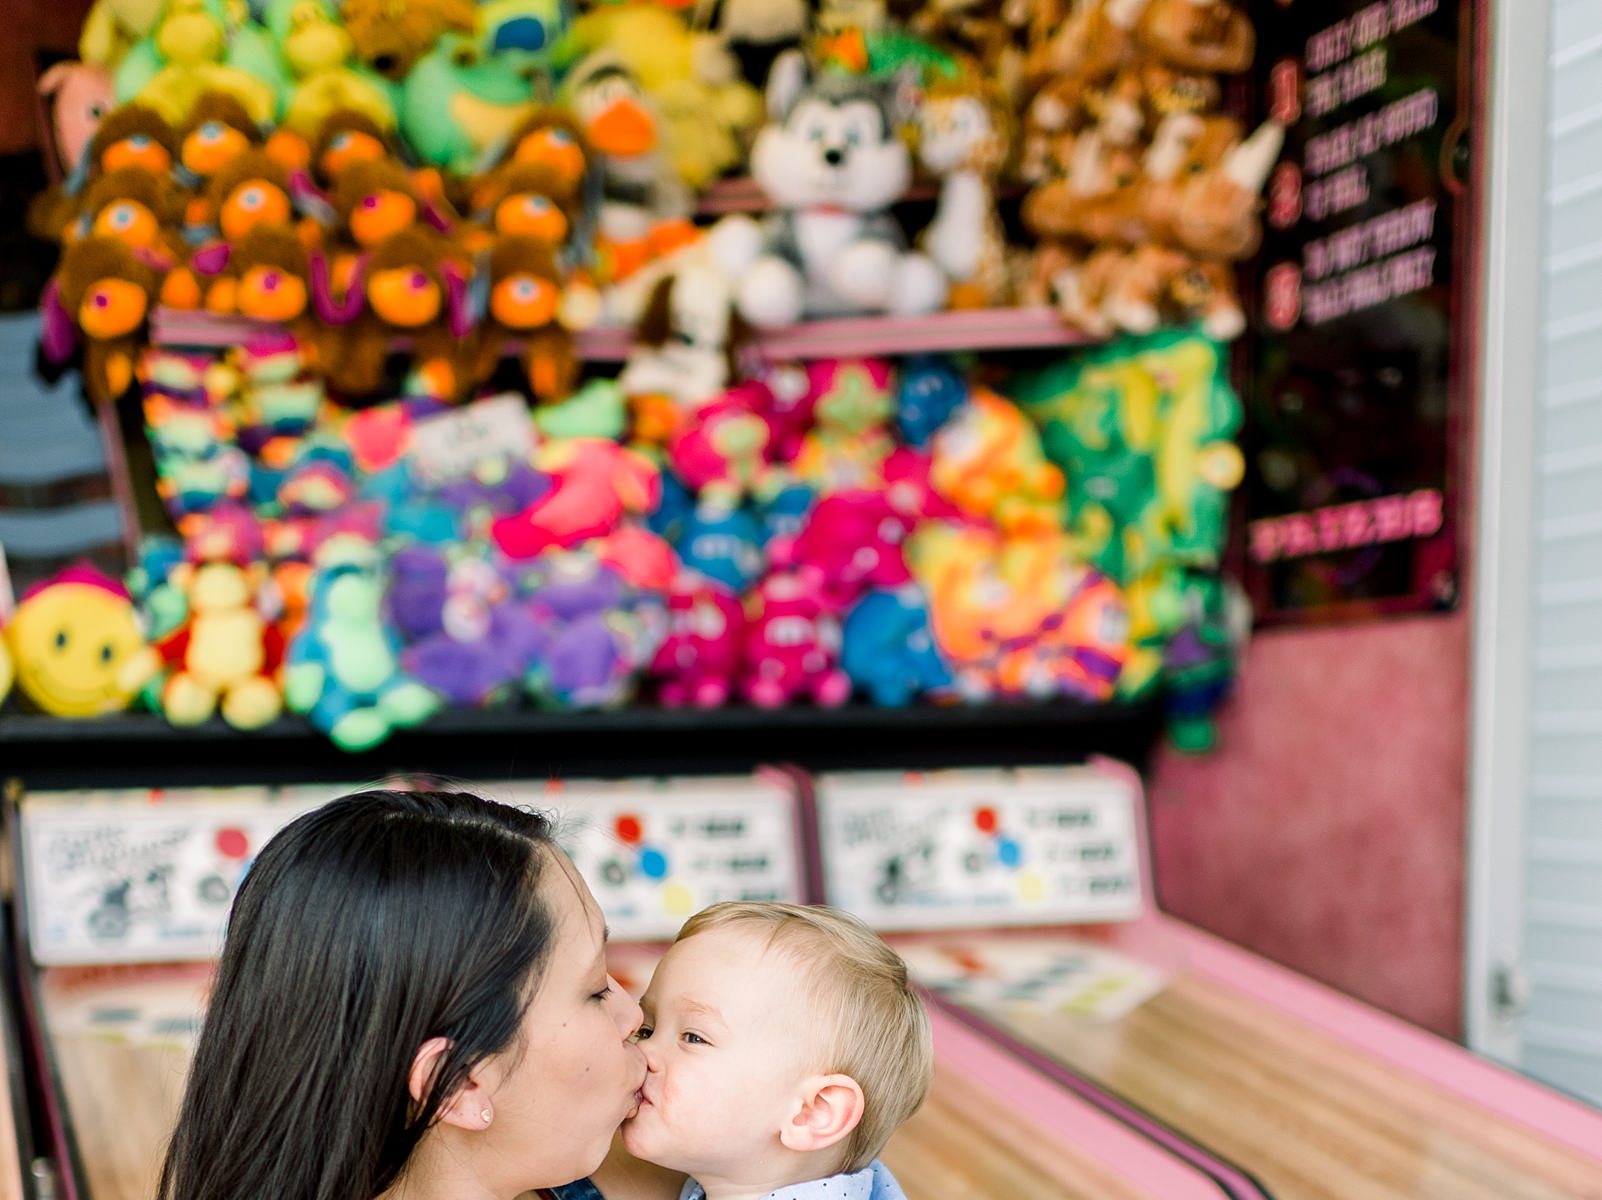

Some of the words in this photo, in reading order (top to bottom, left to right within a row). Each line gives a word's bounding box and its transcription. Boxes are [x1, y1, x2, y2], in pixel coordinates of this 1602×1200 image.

[1271, 60, 1300, 120] 1
[1269, 161, 1301, 228] 2
[1250, 490, 1443, 562] PRIZES
